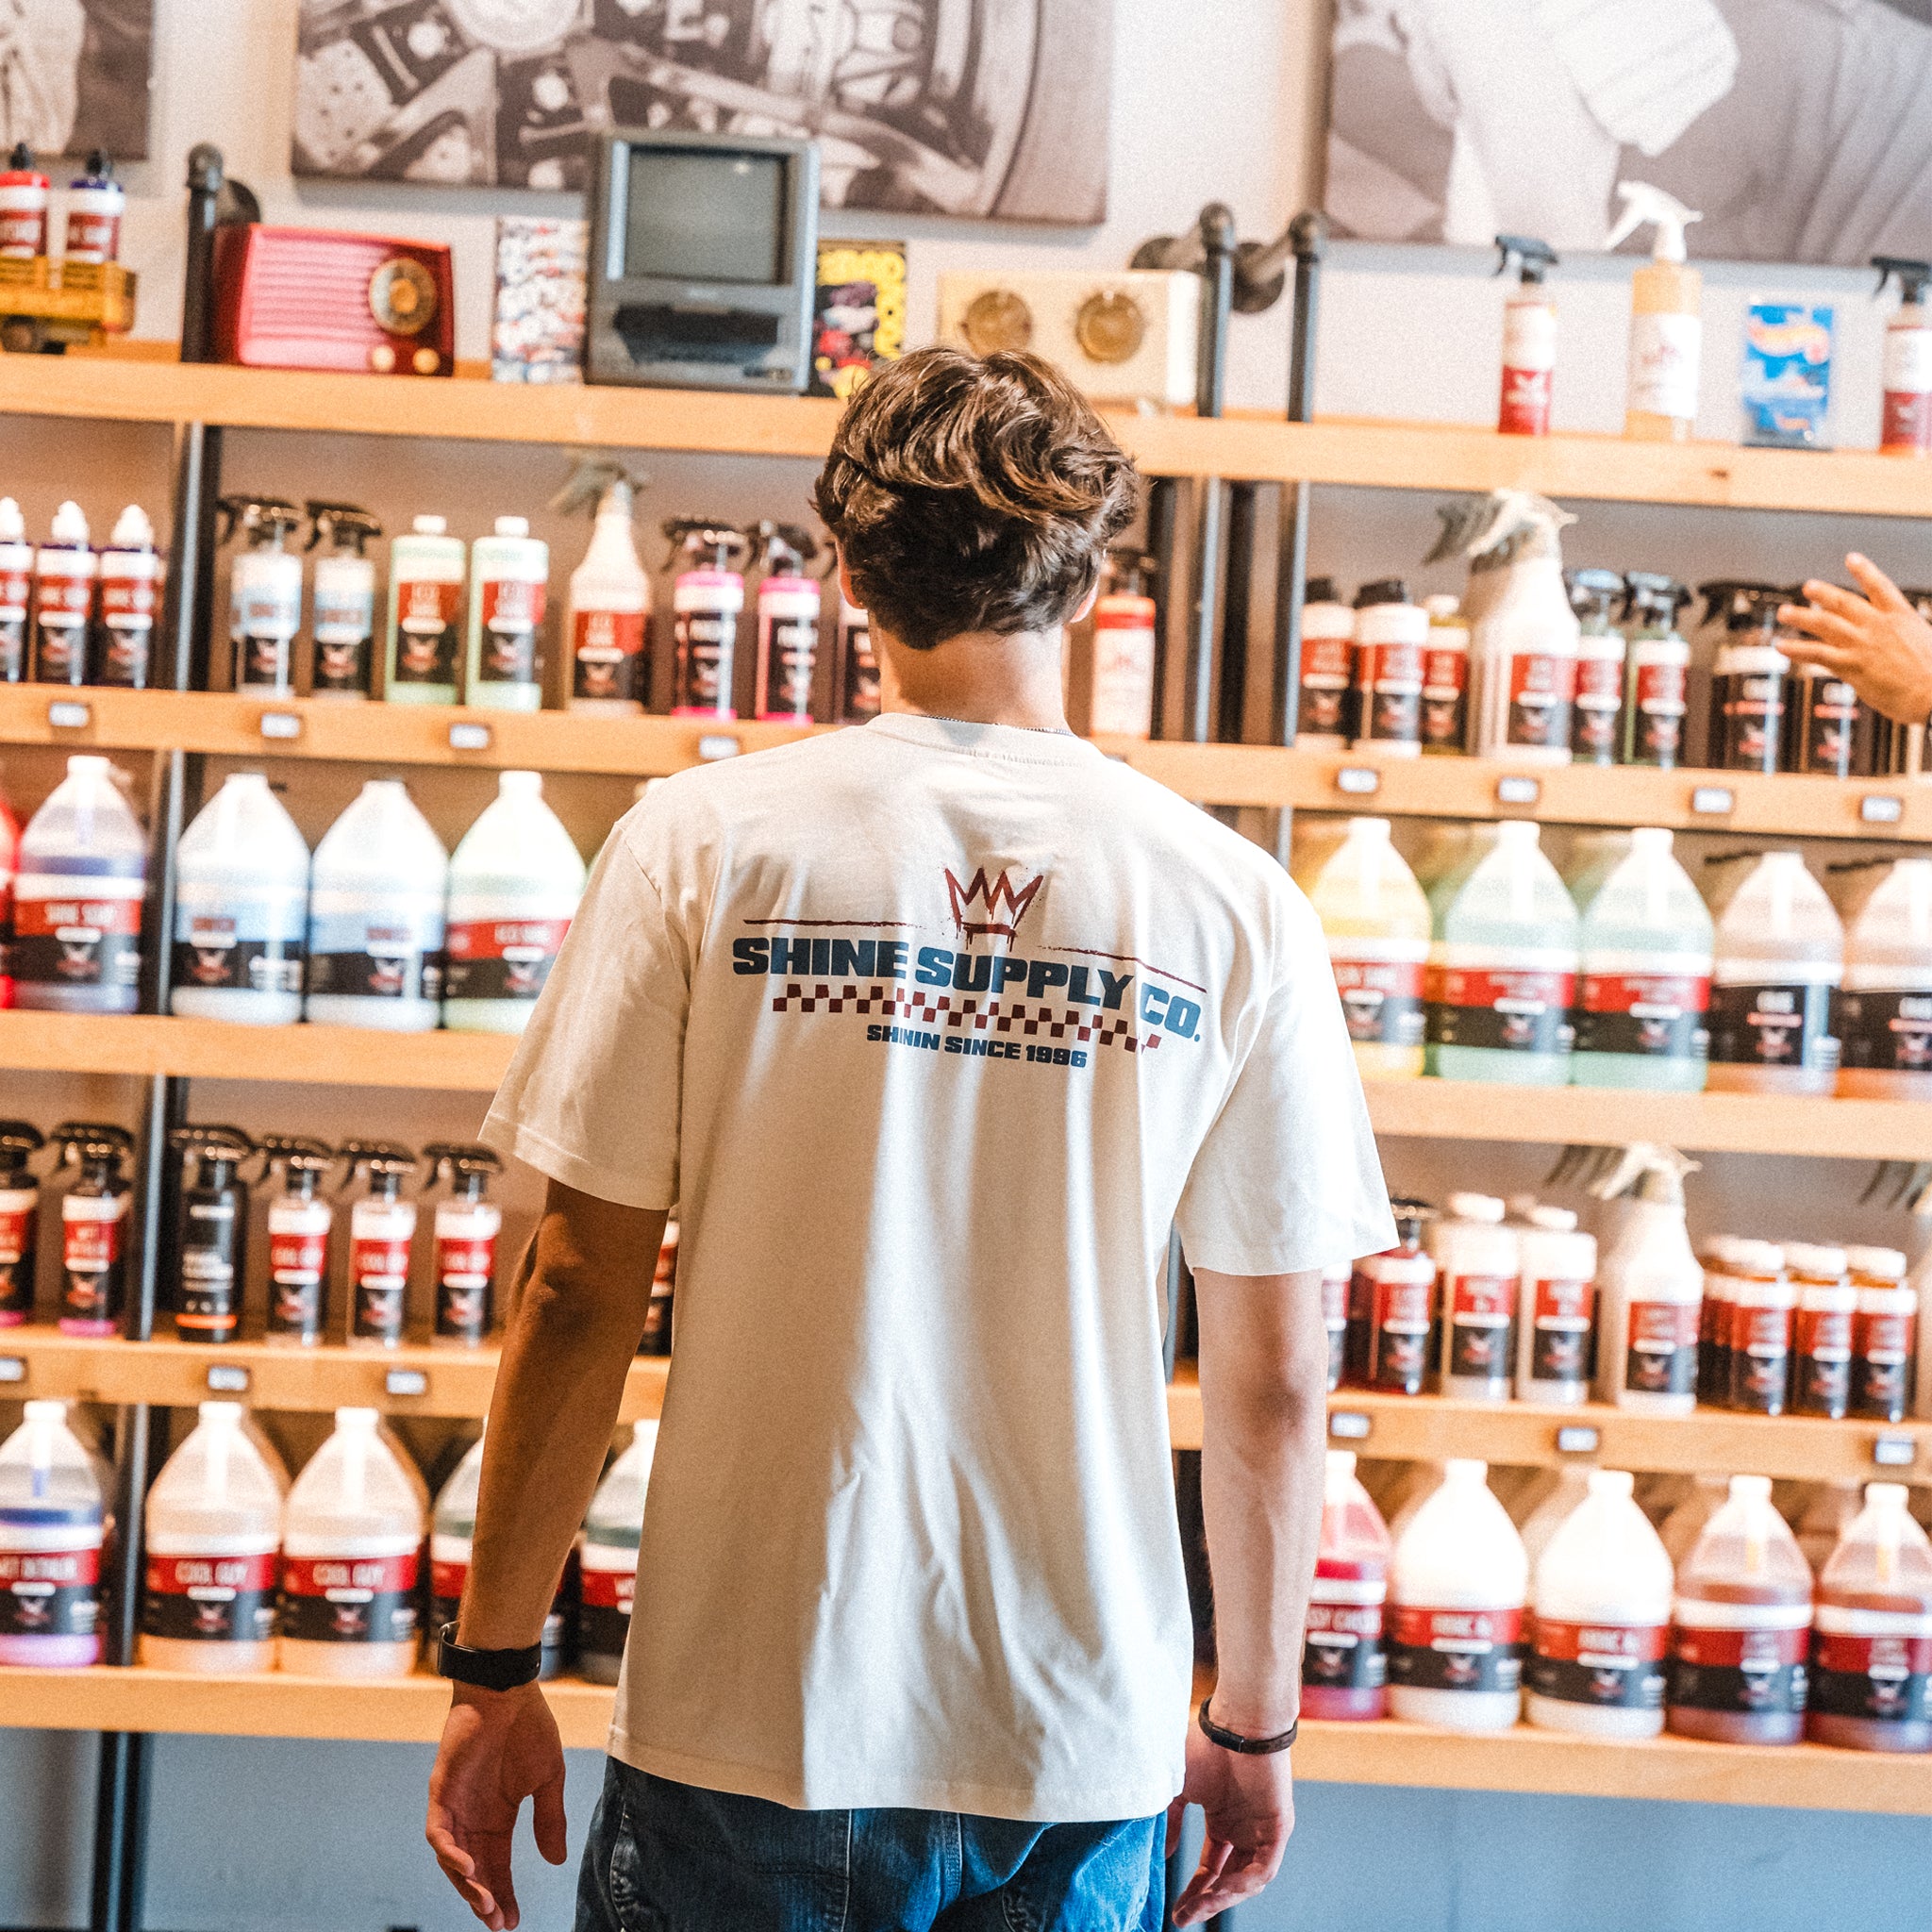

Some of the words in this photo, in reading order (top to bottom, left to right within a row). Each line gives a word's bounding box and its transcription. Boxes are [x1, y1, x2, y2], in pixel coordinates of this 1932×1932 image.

[733, 937, 909, 979] SHINE
[915, 946, 1135, 1010] SUPPLY
[1140, 982, 1202, 1042] CO.
[944, 1036, 1022, 1059] SINCE
[1025, 1044, 1088, 1068] 1996
